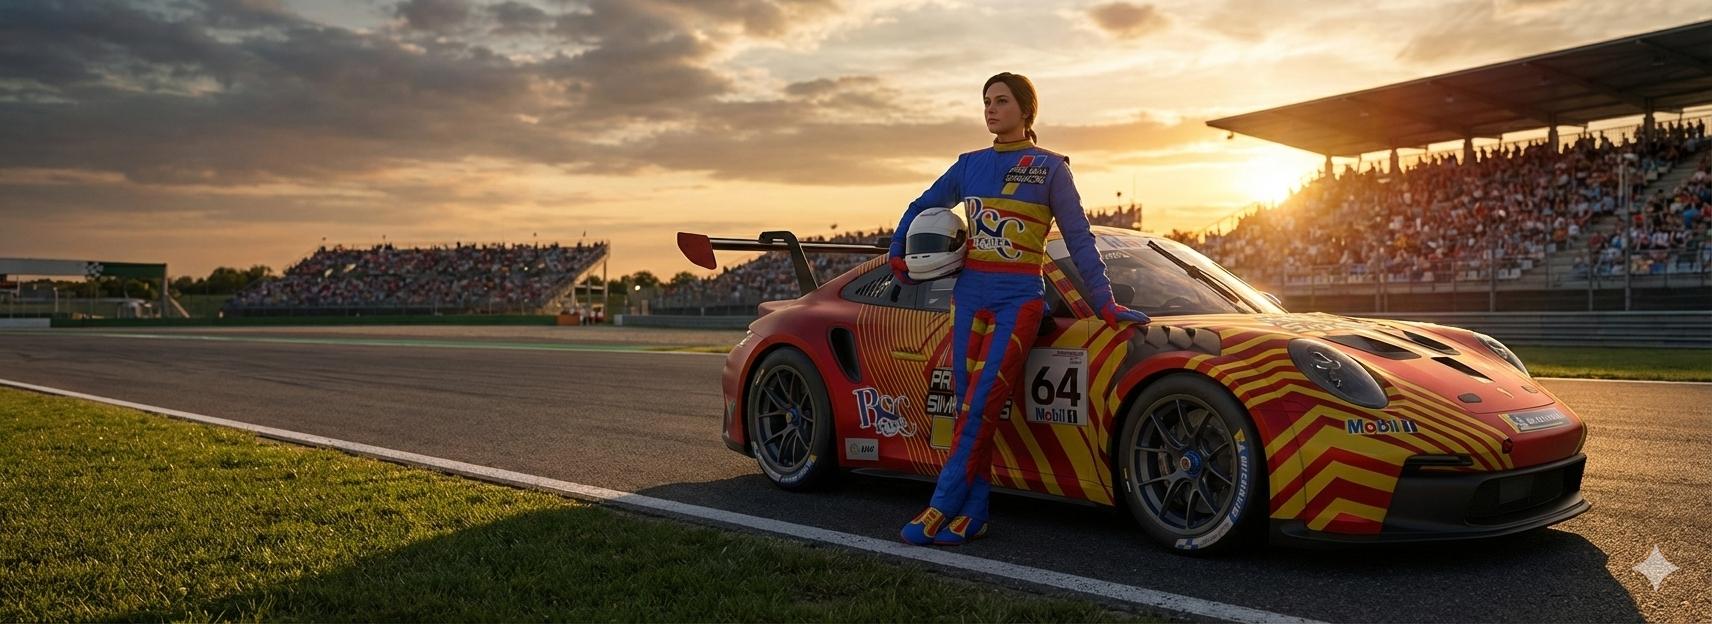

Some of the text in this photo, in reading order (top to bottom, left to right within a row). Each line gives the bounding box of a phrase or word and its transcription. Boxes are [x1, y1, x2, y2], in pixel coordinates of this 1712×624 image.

[930, 370, 953, 390] PR
[1031, 366, 1081, 407] 64
[1035, 407, 1066, 423] Mobil
